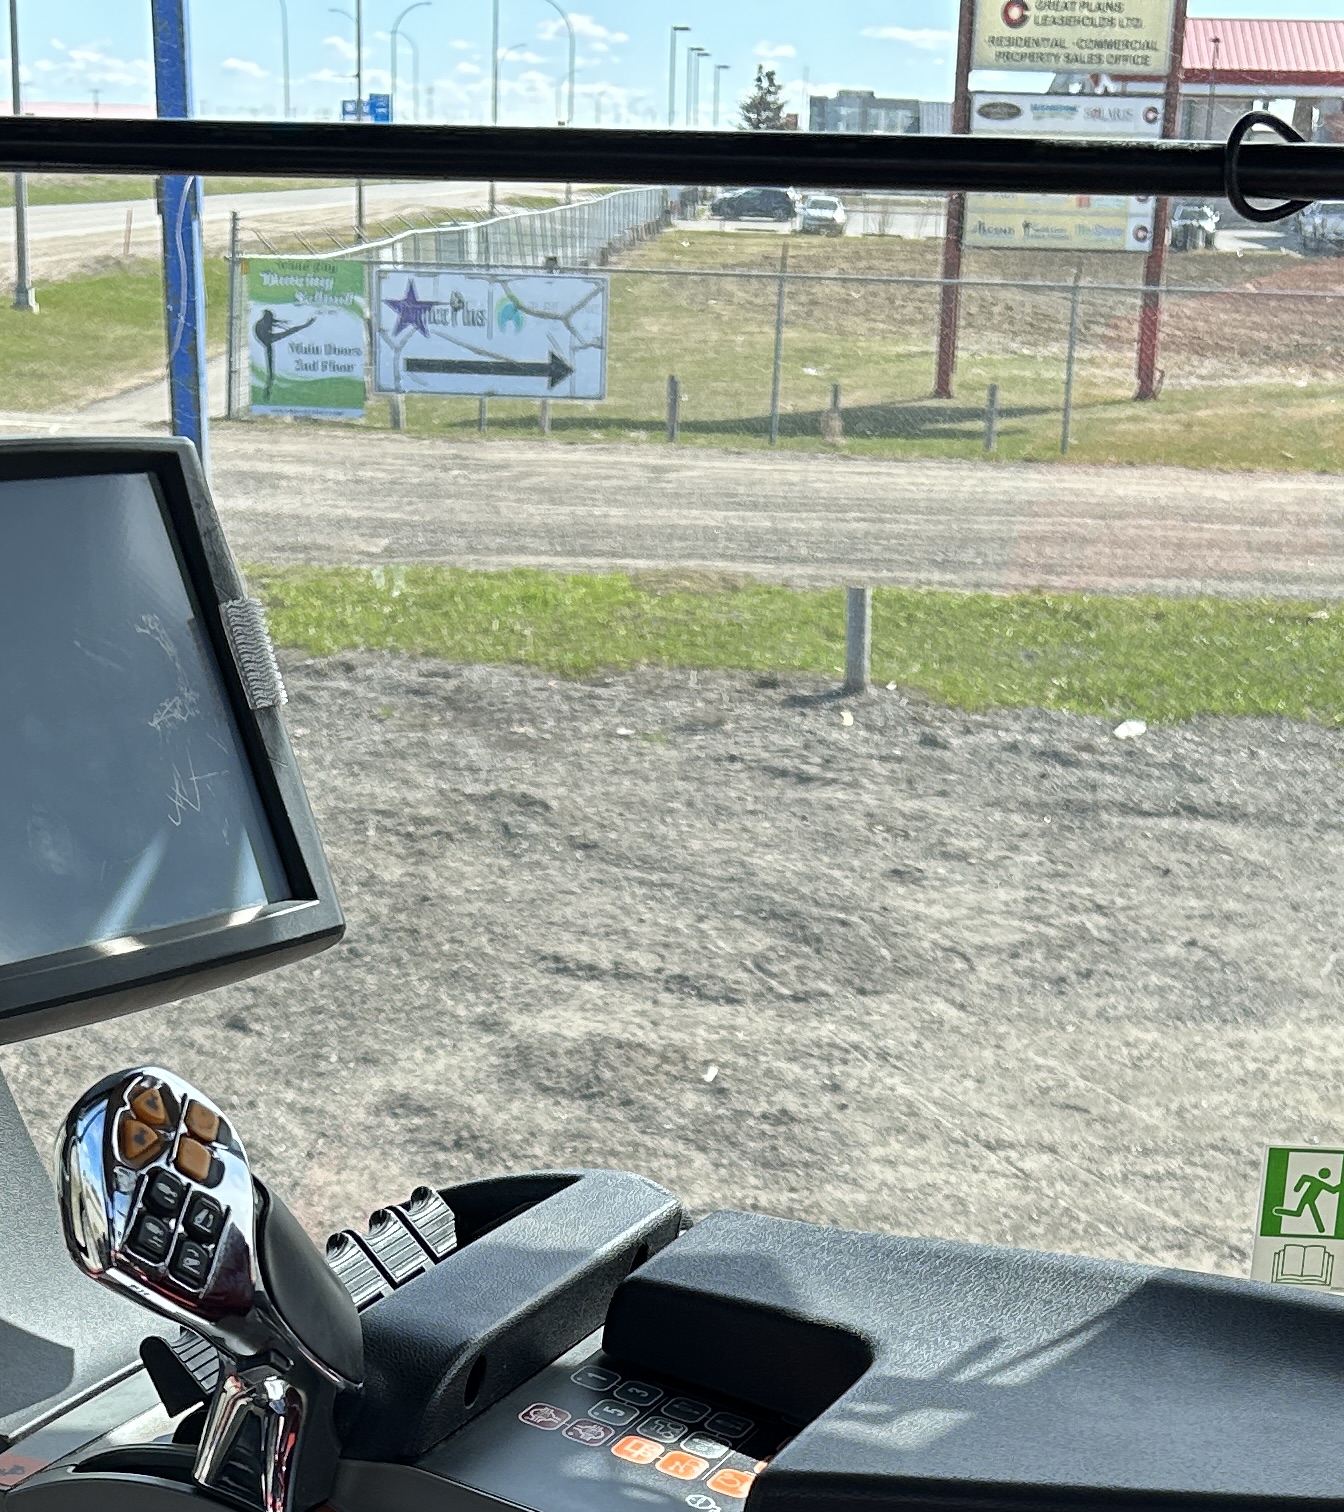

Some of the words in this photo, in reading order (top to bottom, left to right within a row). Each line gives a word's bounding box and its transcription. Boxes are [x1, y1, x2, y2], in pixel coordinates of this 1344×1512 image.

[994, 51, 1061, 64] PROPERTY
[1064, 53, 1103, 65] SALES
[1106, 54, 1151, 66] OFFICE
[602, 1405, 626, 1418] 5
